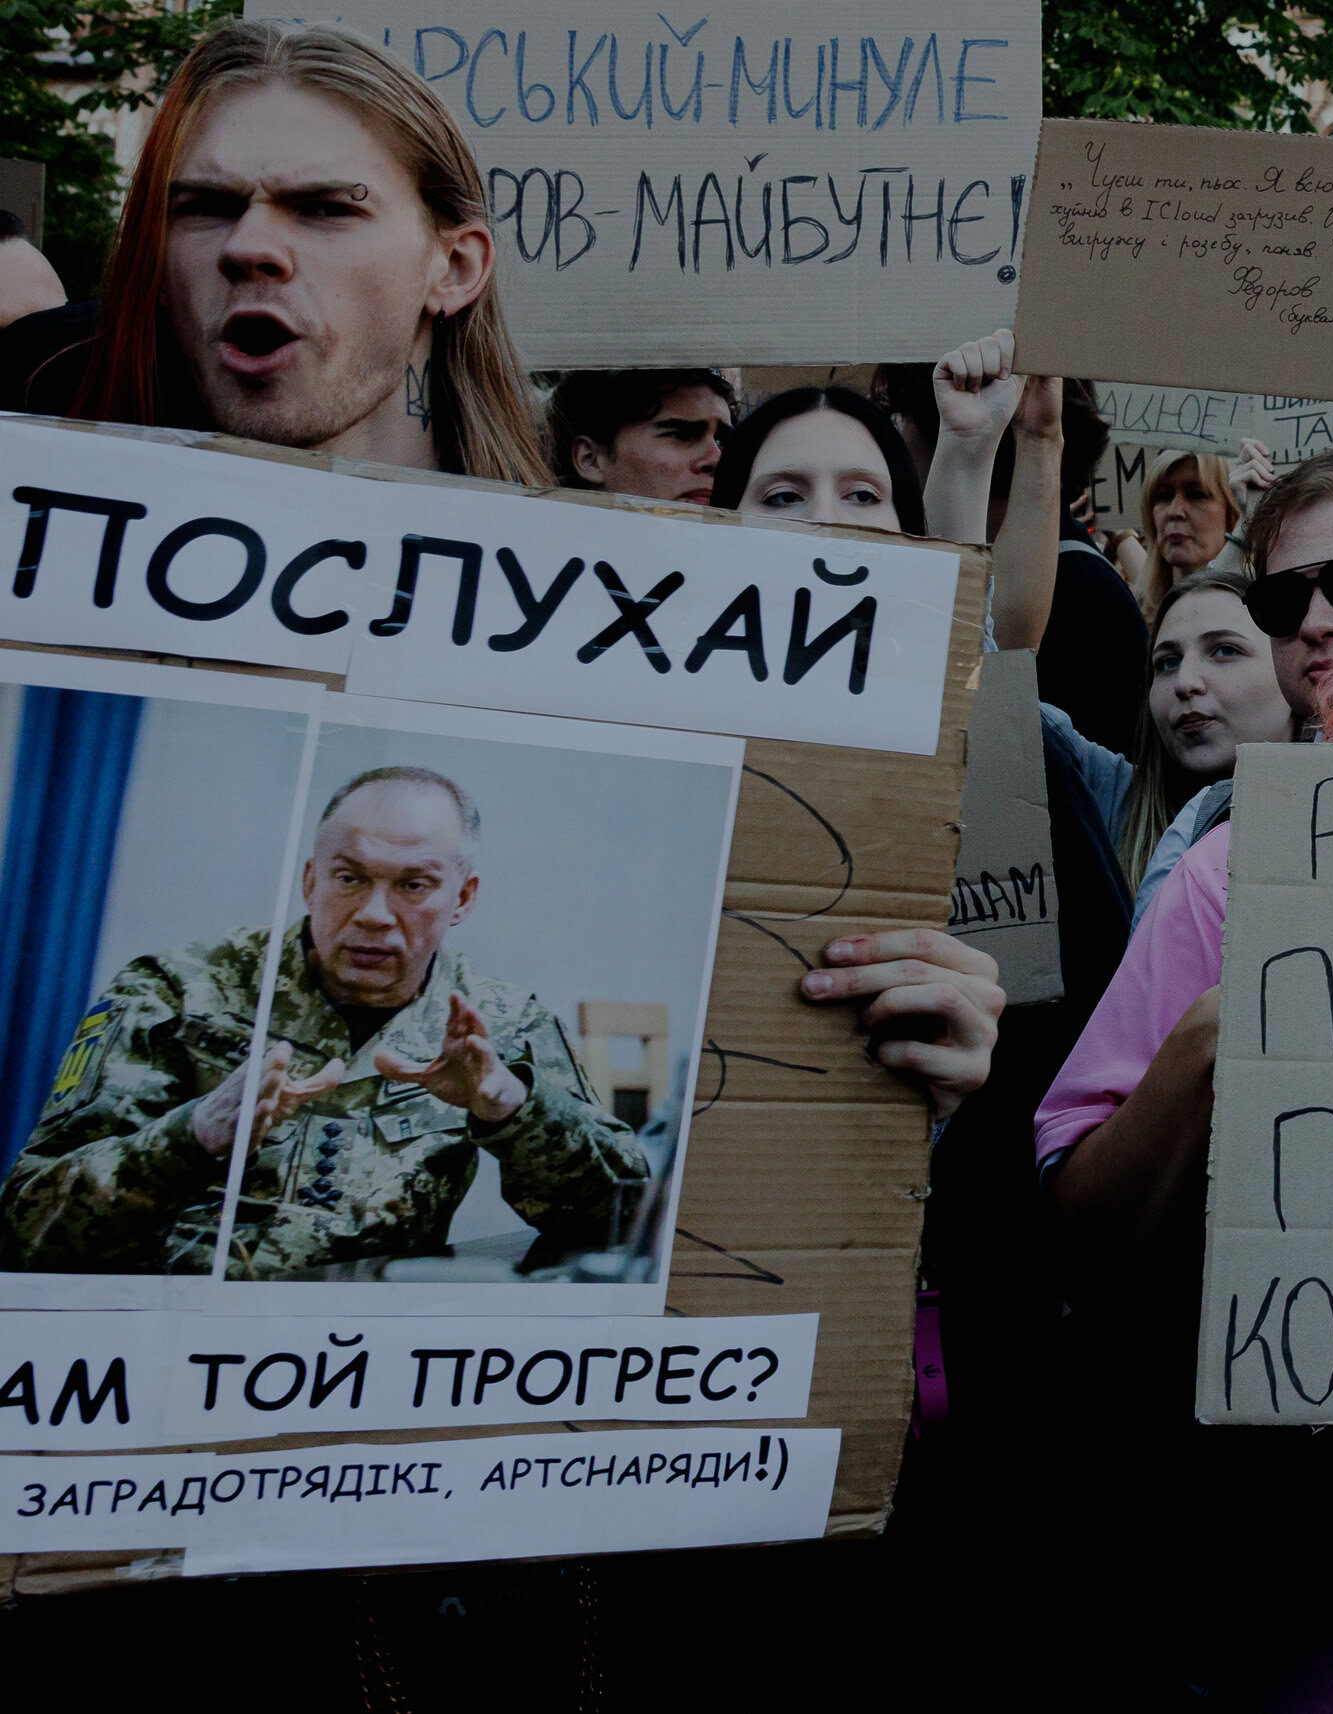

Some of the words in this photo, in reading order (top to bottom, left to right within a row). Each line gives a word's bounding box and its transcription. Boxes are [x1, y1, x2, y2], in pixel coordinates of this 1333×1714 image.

[1256, 166, 1285, 192] Я
[12, 486, 878, 696] ПОСЛУХАЙ
[190, 1333, 369, 1412] ТОЙ
[410, 1345, 780, 1409] ПРОГРЕС?
[17, 1462, 454, 1518] ЗАГРАДОТРЯДІКІ,
[480, 1435, 791, 1494] АРТСНАРЯДИ!)
